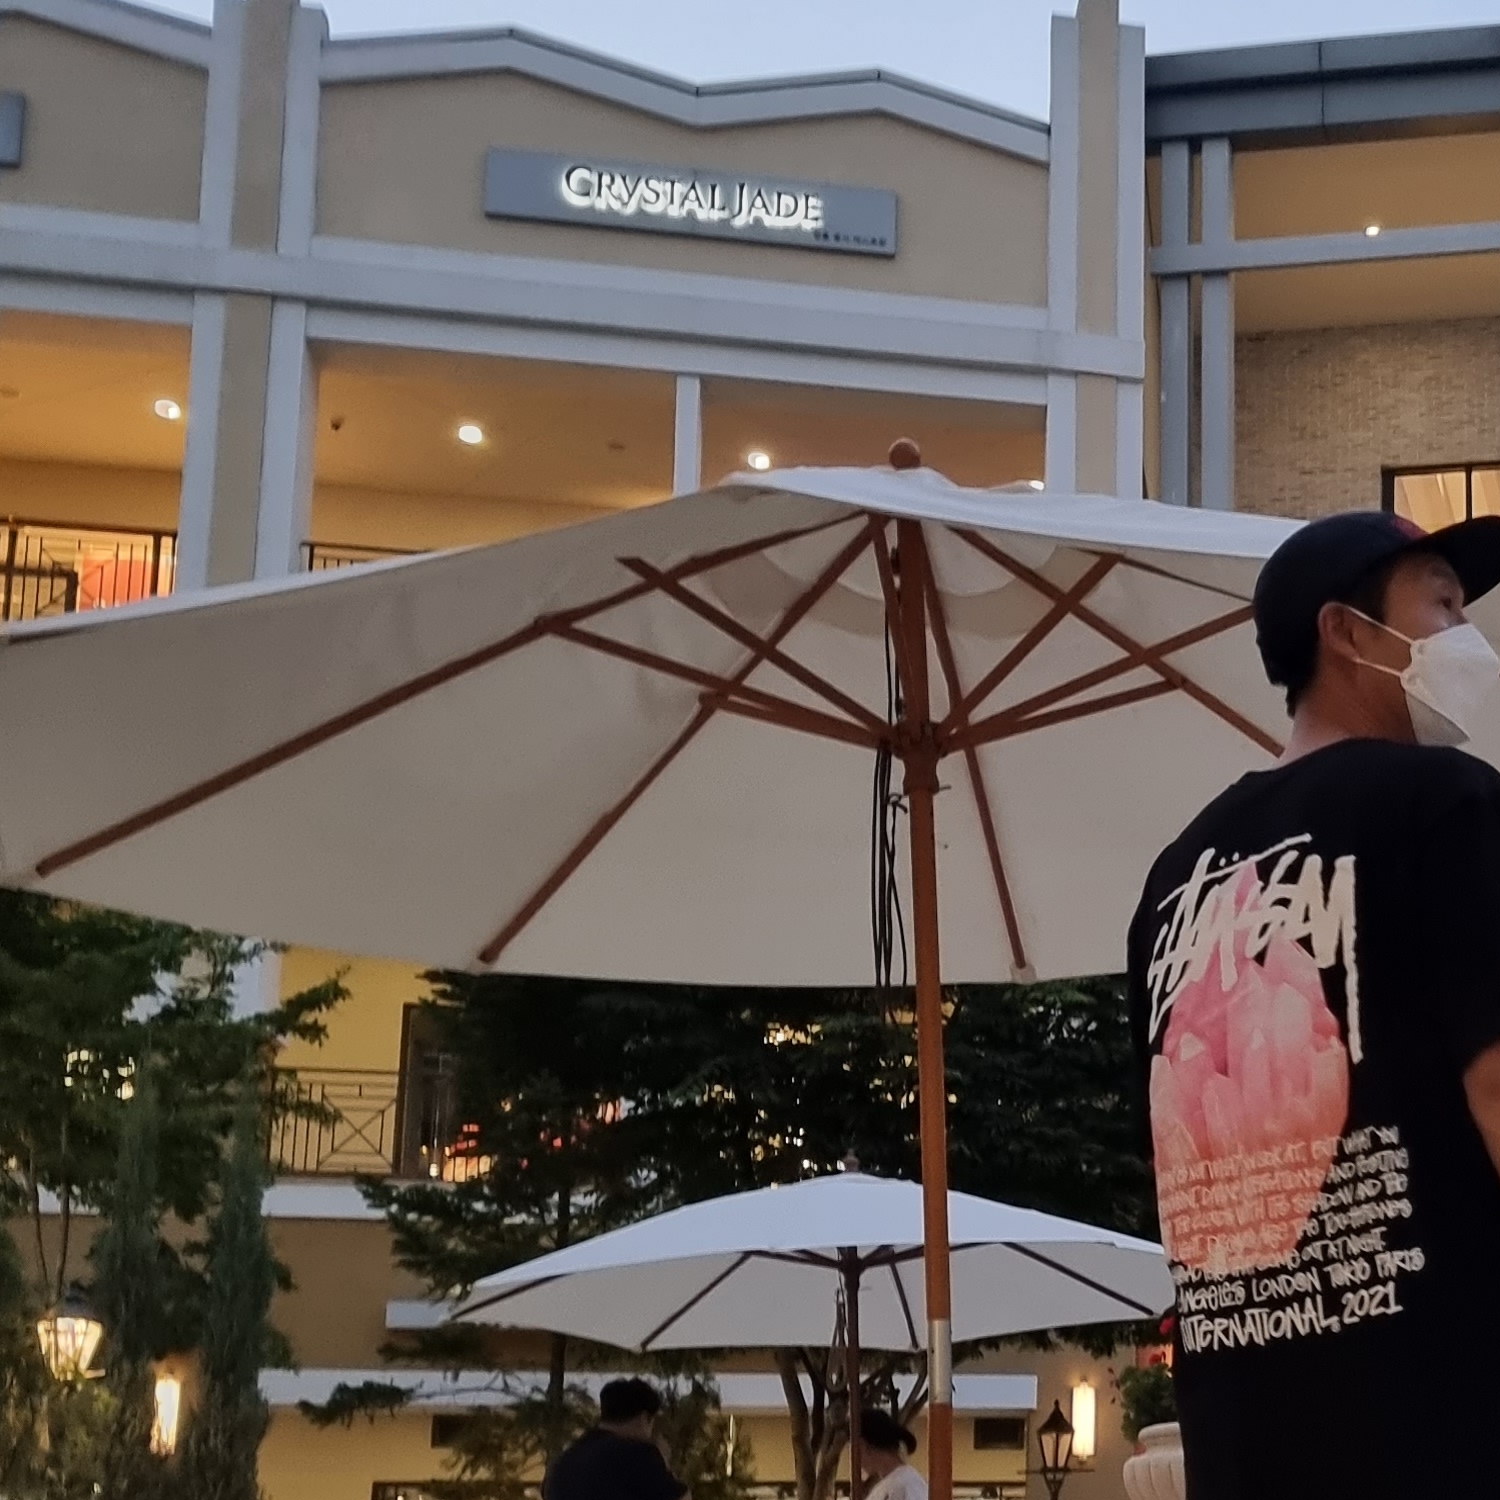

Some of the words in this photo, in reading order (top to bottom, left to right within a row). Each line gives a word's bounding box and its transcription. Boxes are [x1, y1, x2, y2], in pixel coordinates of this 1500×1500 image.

[563, 165, 731, 220] CRYSTAL
[732, 182, 826, 229] JADE
[1252, 1266, 1321, 1302] LONDON
[1341, 1280, 1404, 1325] 2021
